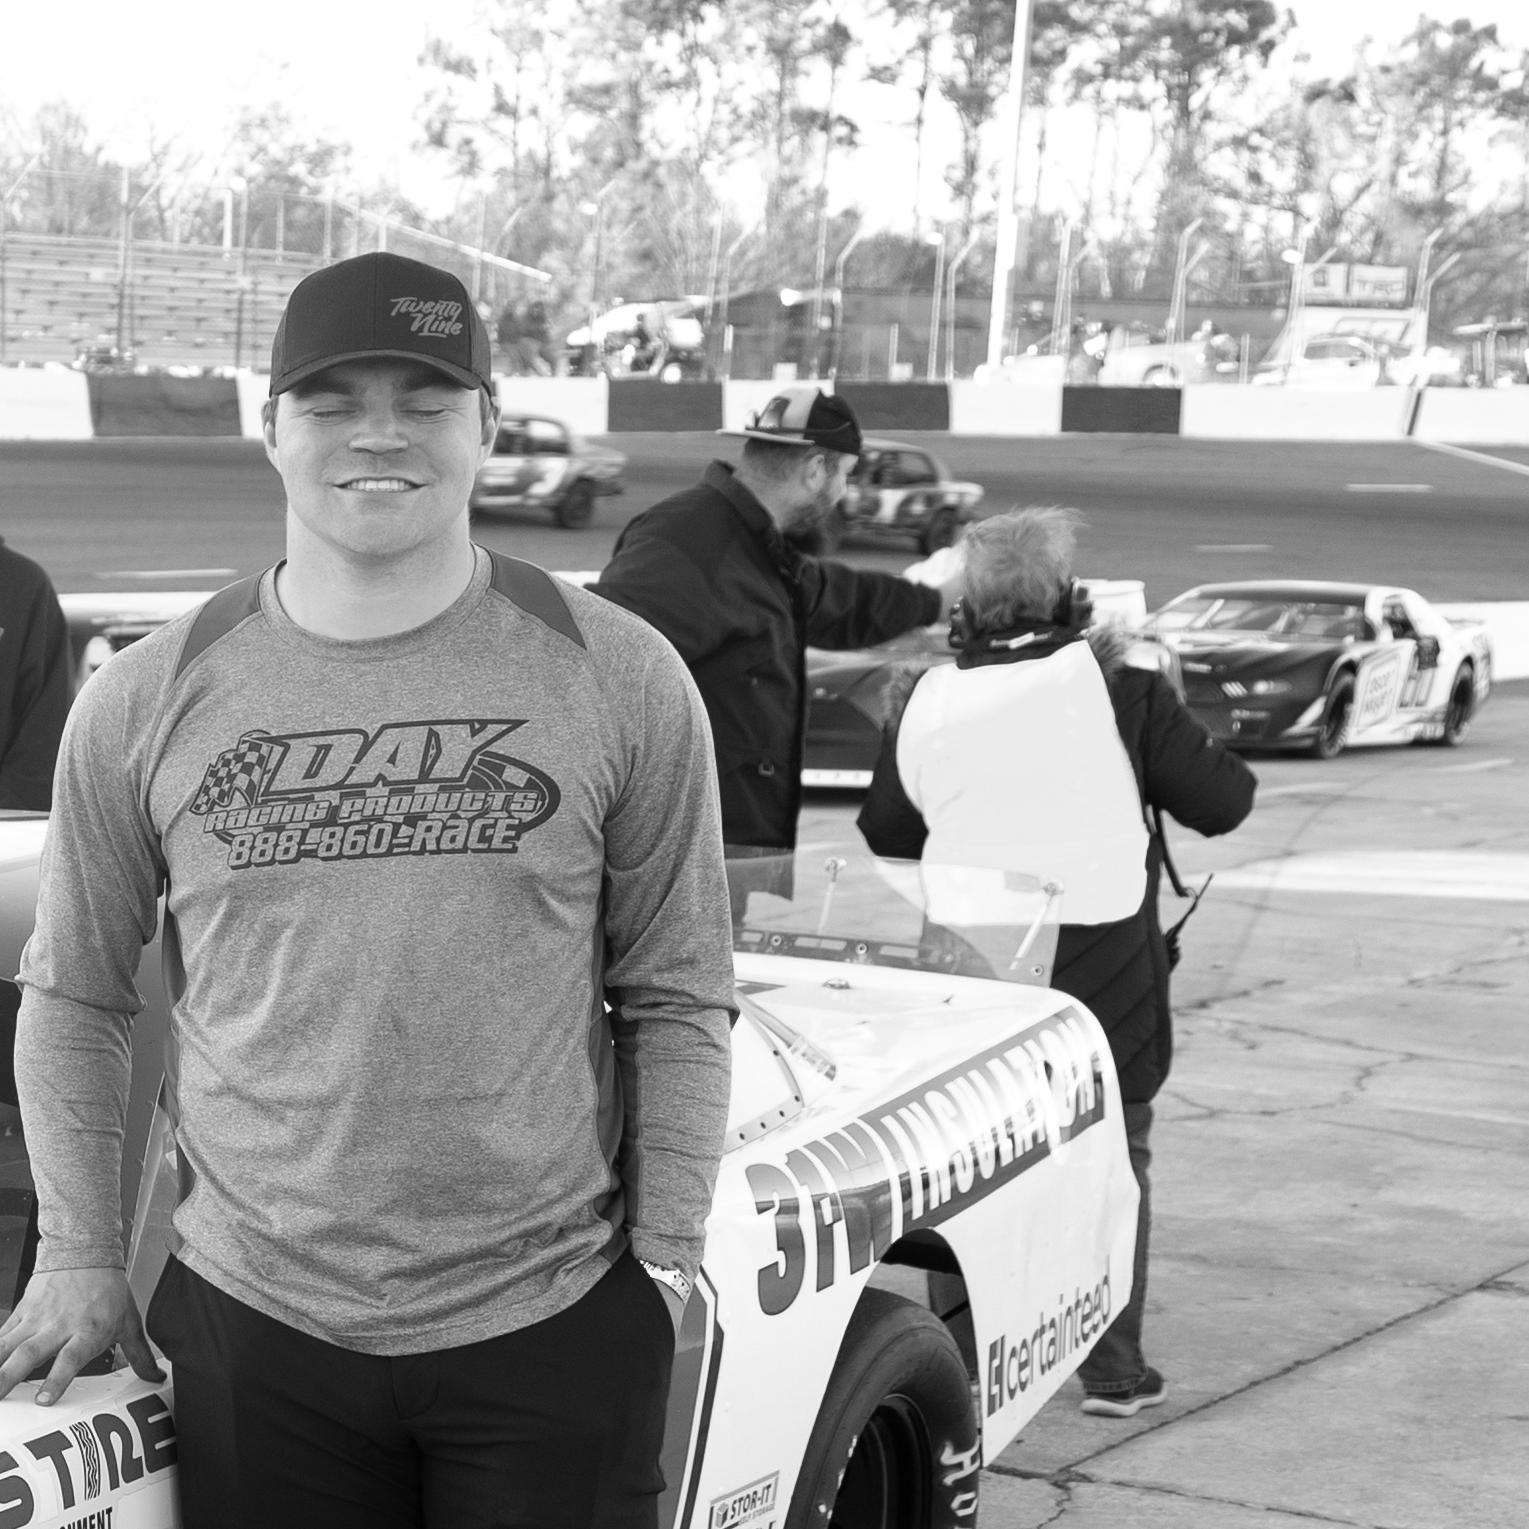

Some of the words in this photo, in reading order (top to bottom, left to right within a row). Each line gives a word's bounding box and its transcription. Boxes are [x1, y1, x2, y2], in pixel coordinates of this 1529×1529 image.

[390, 297, 462, 322] Twenty
[410, 313, 463, 338] Nine
[255, 719, 530, 798] DAY
[337, 789, 542, 824] PRODUCTS
[1007, 1254, 1111, 1401] certainteed
[22, 1392, 178, 1511] TIRE
[730, 1483, 772, 1521] STOR-IT
